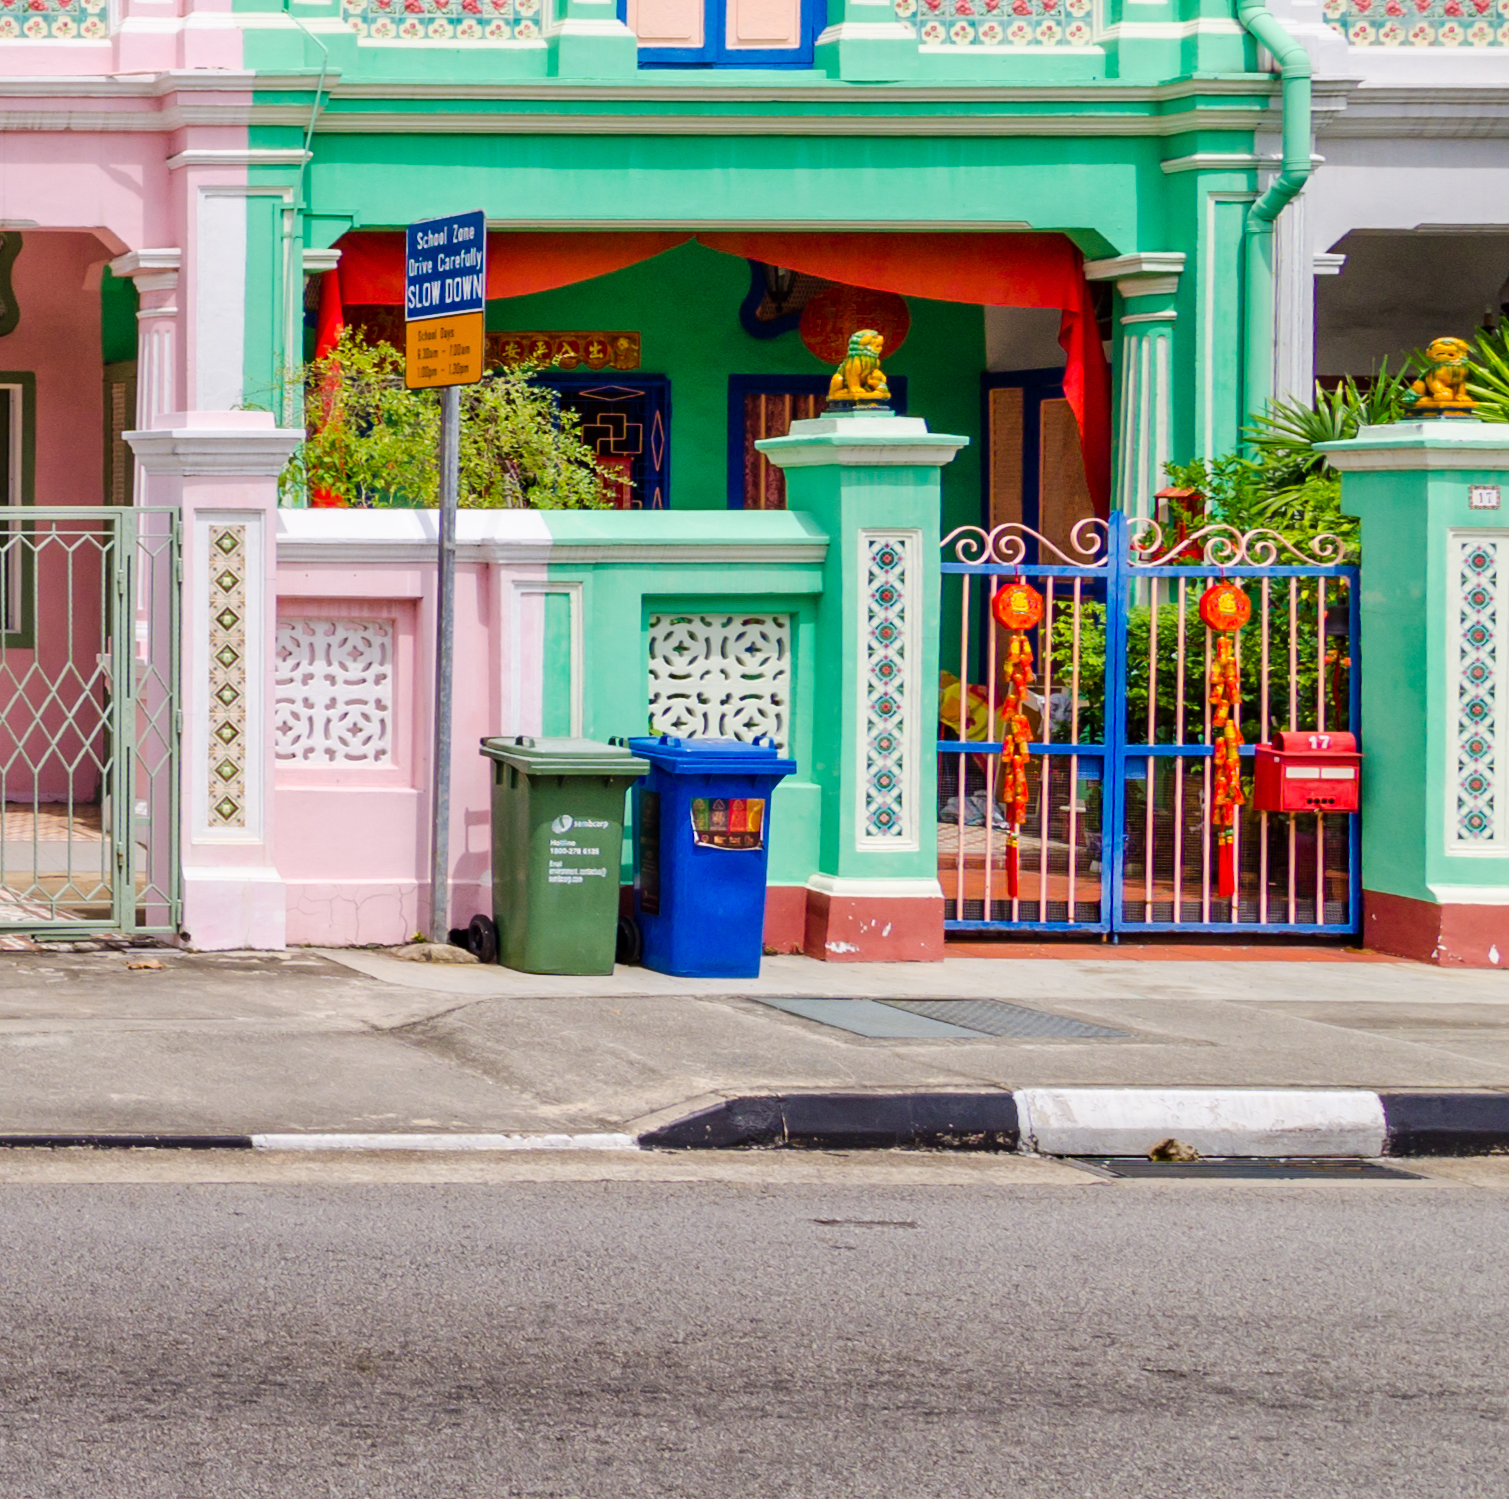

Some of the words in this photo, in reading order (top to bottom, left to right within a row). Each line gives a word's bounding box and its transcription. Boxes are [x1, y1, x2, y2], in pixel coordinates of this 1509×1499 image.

[417, 226, 448, 250] School
[452, 223, 475, 244] Zone
[408, 257, 433, 277] Drive
[437, 247, 483, 272] Carefully
[408, 280, 441, 309] SLOW
[445, 273, 483, 304] DOWN
[418, 329, 437, 342] School
[1479, 492, 1493, 504] 17
[1308, 735, 1331, 749] 17
[573, 819, 609, 830] sembcorp
